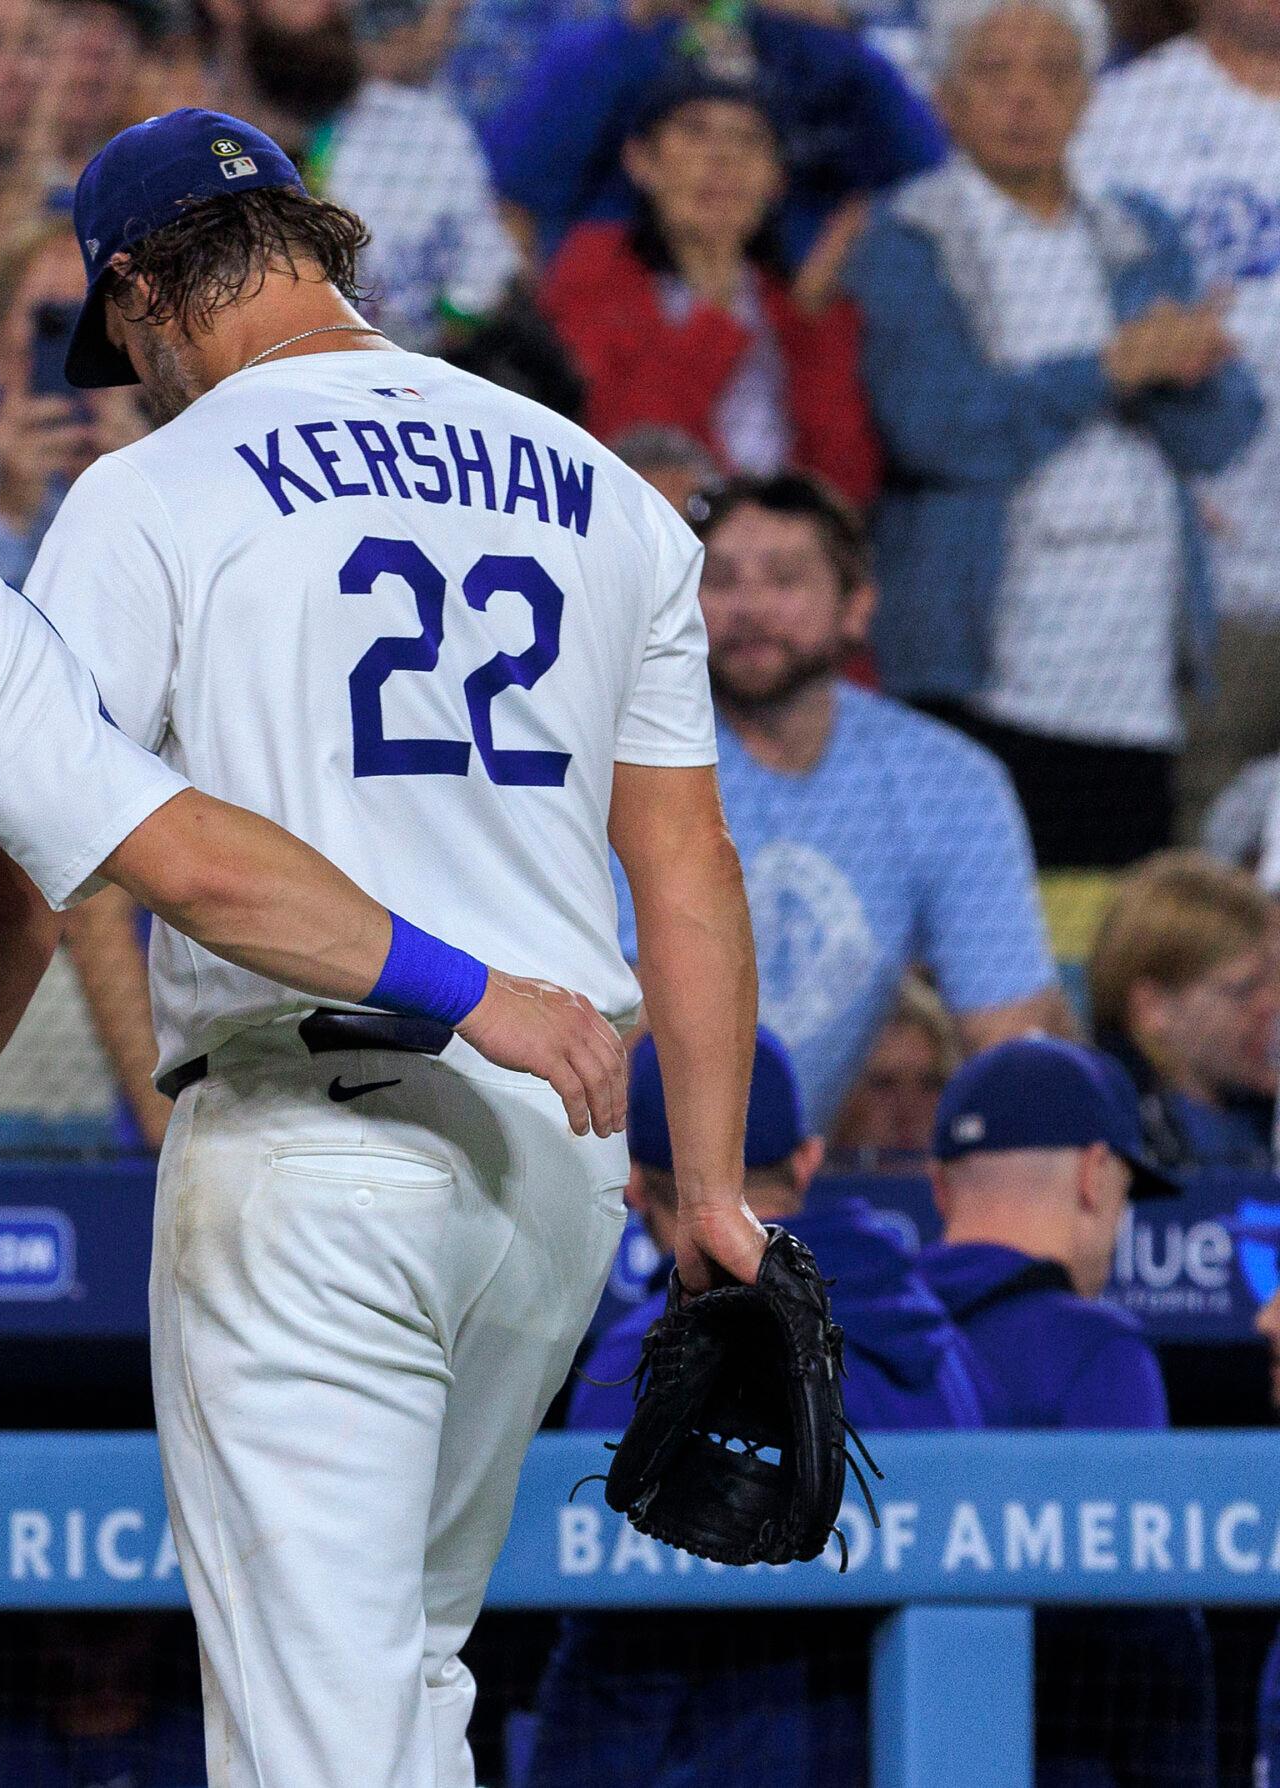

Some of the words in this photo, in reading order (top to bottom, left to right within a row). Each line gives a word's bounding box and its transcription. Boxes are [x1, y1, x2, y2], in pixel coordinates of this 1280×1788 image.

[217, 142, 237, 153] 21
[234, 420, 594, 538] KERSHAW
[338, 535, 573, 788] 22
